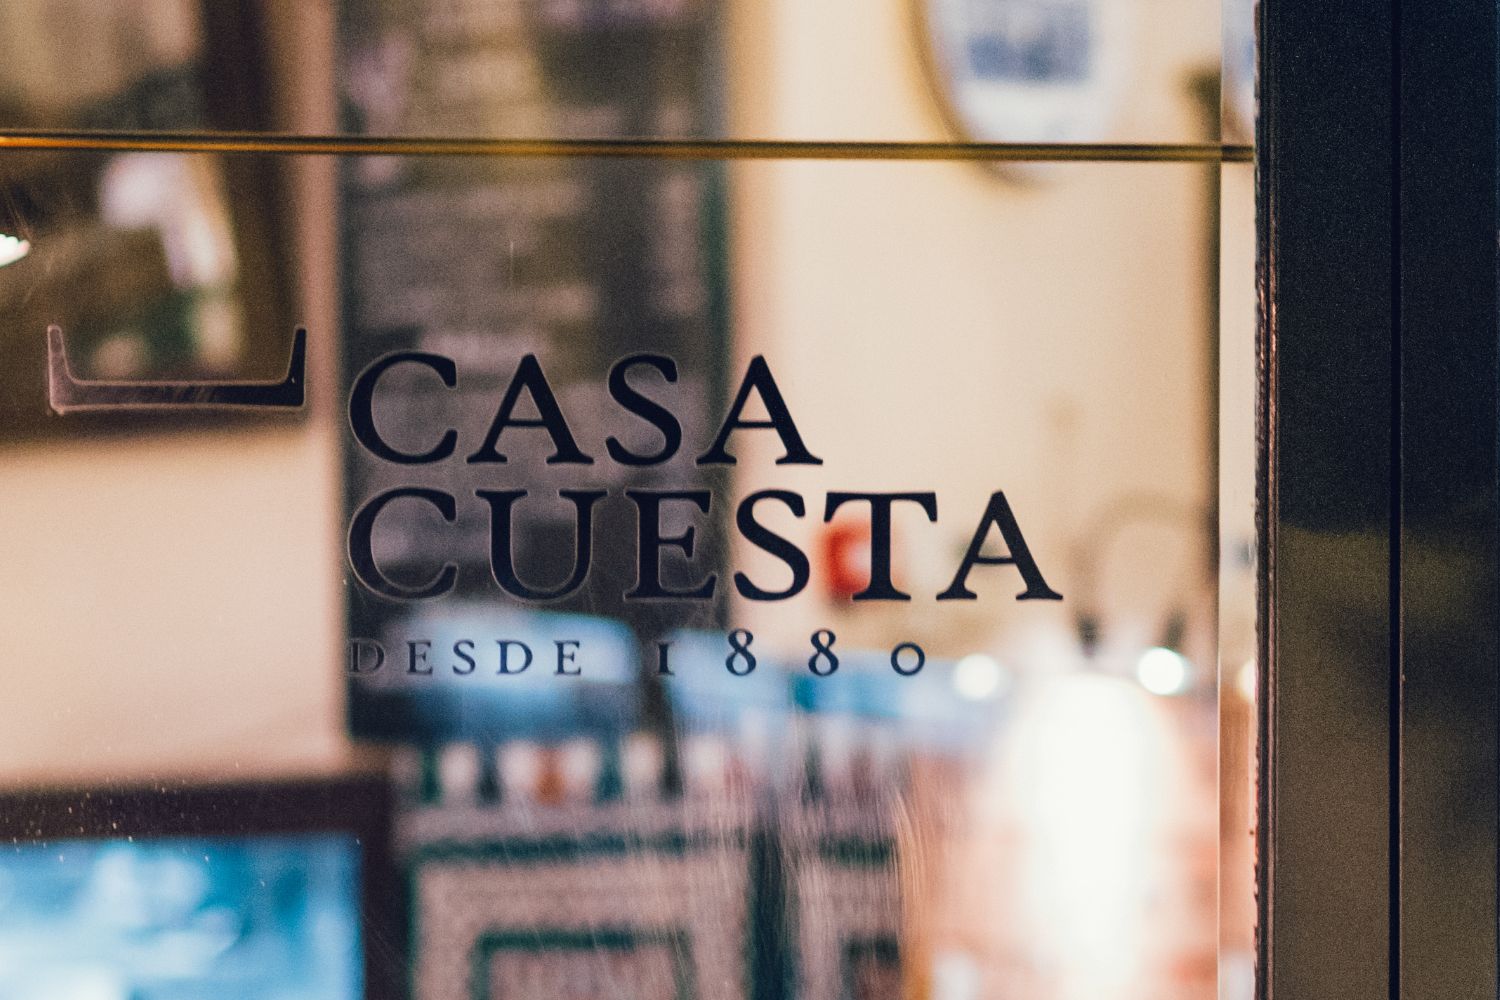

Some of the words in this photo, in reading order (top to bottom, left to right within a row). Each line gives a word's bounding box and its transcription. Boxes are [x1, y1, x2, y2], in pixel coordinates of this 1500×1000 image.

[349, 351, 823, 466] CASA
[348, 487, 1064, 601] CUESTA
[350, 639, 582, 677] DESDE
[657, 628, 925, 677] 1880
